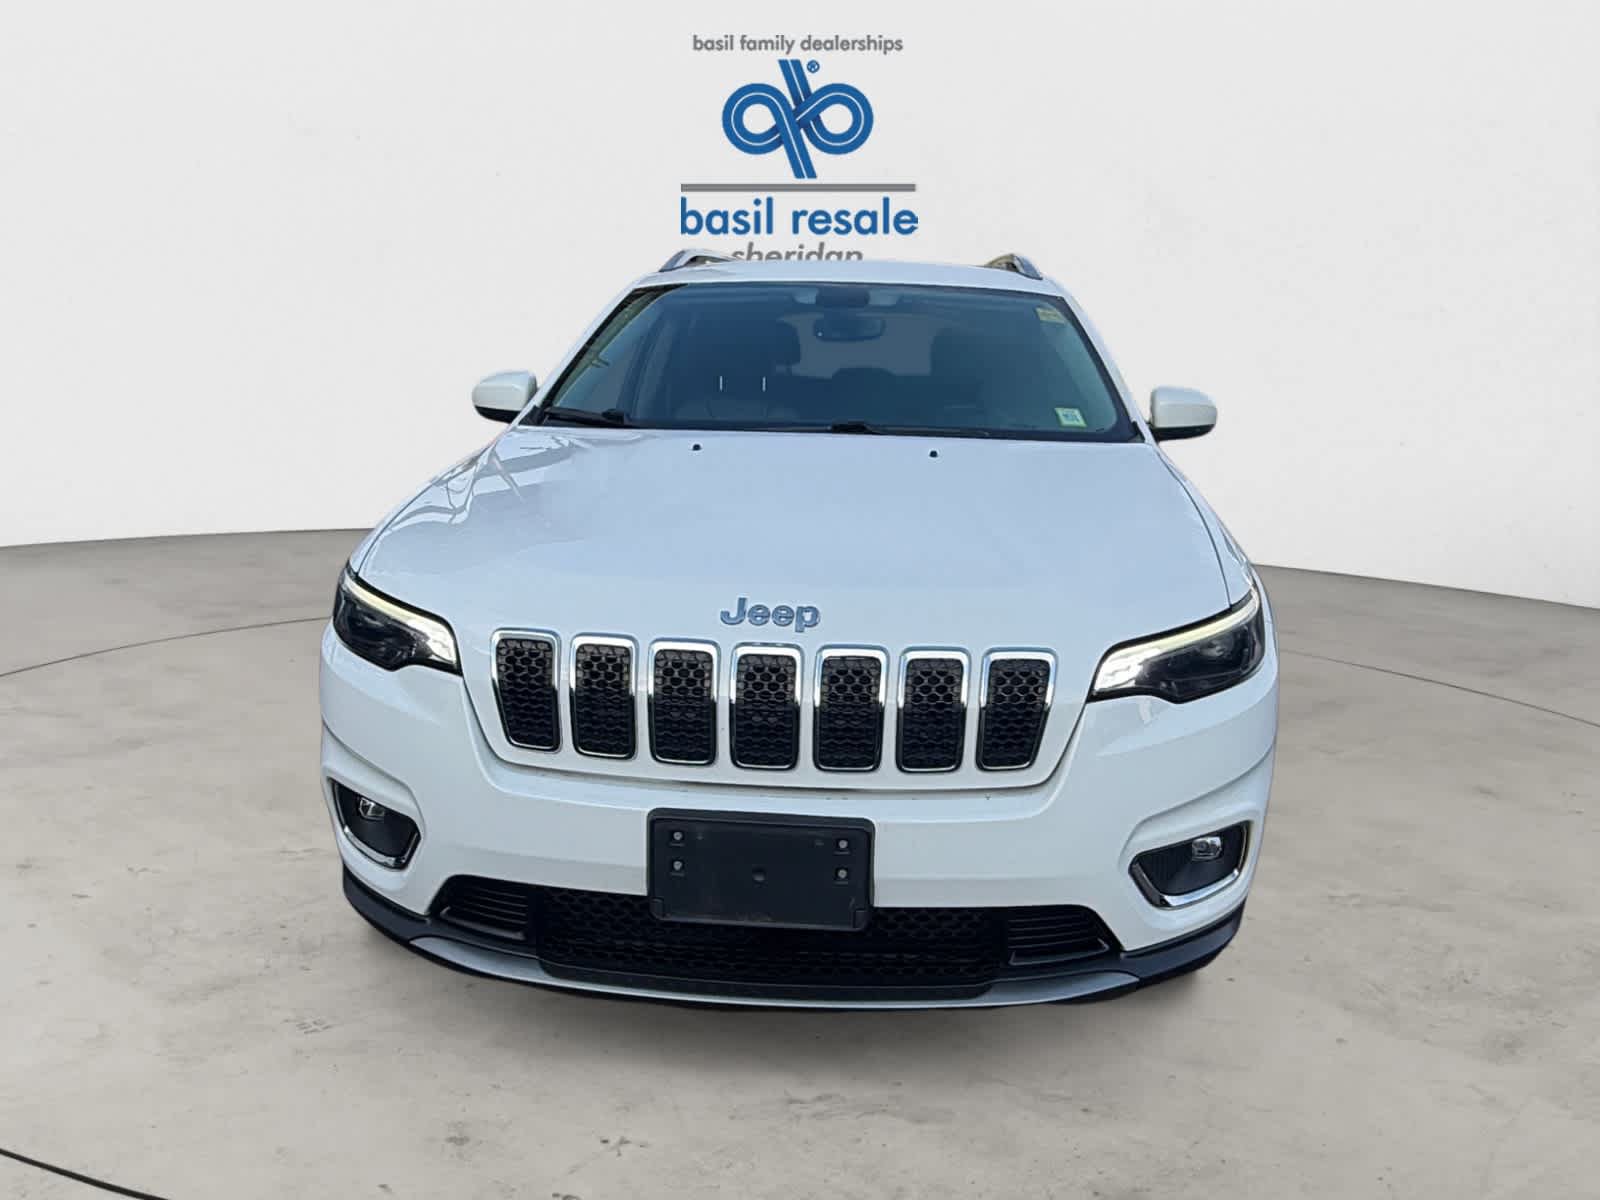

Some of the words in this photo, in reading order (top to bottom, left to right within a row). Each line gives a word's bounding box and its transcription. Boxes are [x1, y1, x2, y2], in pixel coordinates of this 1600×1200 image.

[693, 35, 734, 51] basil
[739, 35, 795, 55] family
[799, 35, 904, 55] dealerships
[680, 196, 774, 235] basil
[791, 196, 919, 235] resale
[732, 241, 864, 262] sheridan
[720, 597, 820, 633] Jeep
